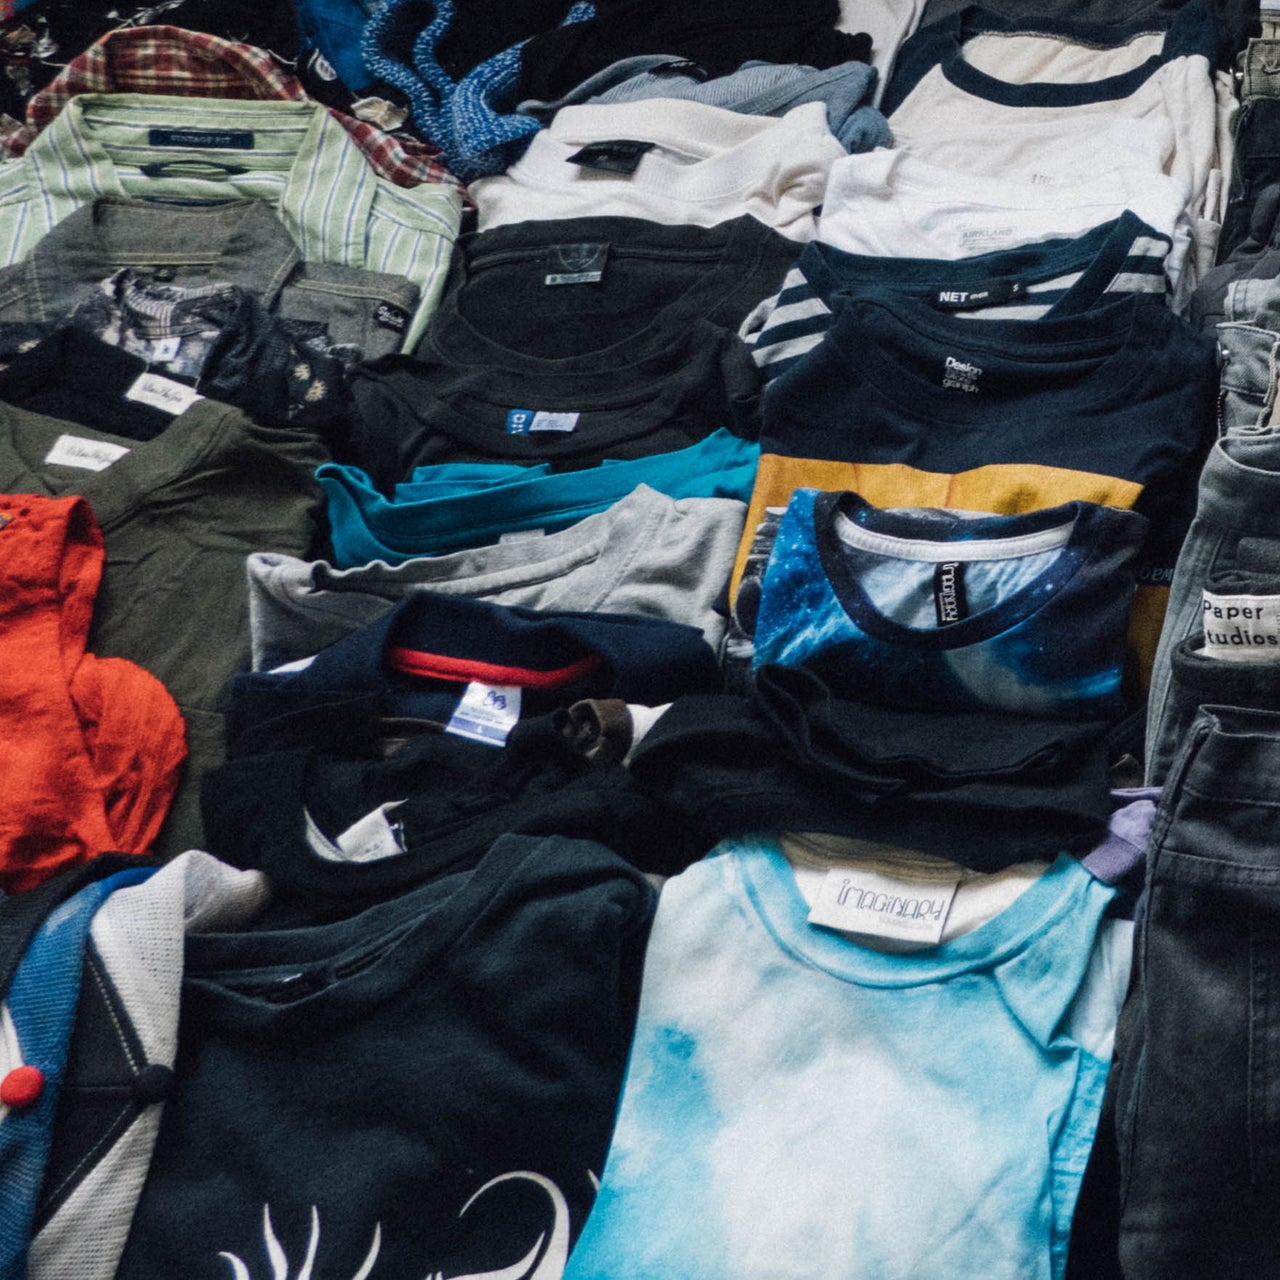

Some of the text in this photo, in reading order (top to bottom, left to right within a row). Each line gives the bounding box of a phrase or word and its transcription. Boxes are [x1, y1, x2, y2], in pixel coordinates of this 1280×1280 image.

[962, 228, 1013, 239] KIRKLAND
[940, 291, 969, 302] NET
[1203, 600, 1263, 620] Paper
[1206, 626, 1279, 646] tudios
